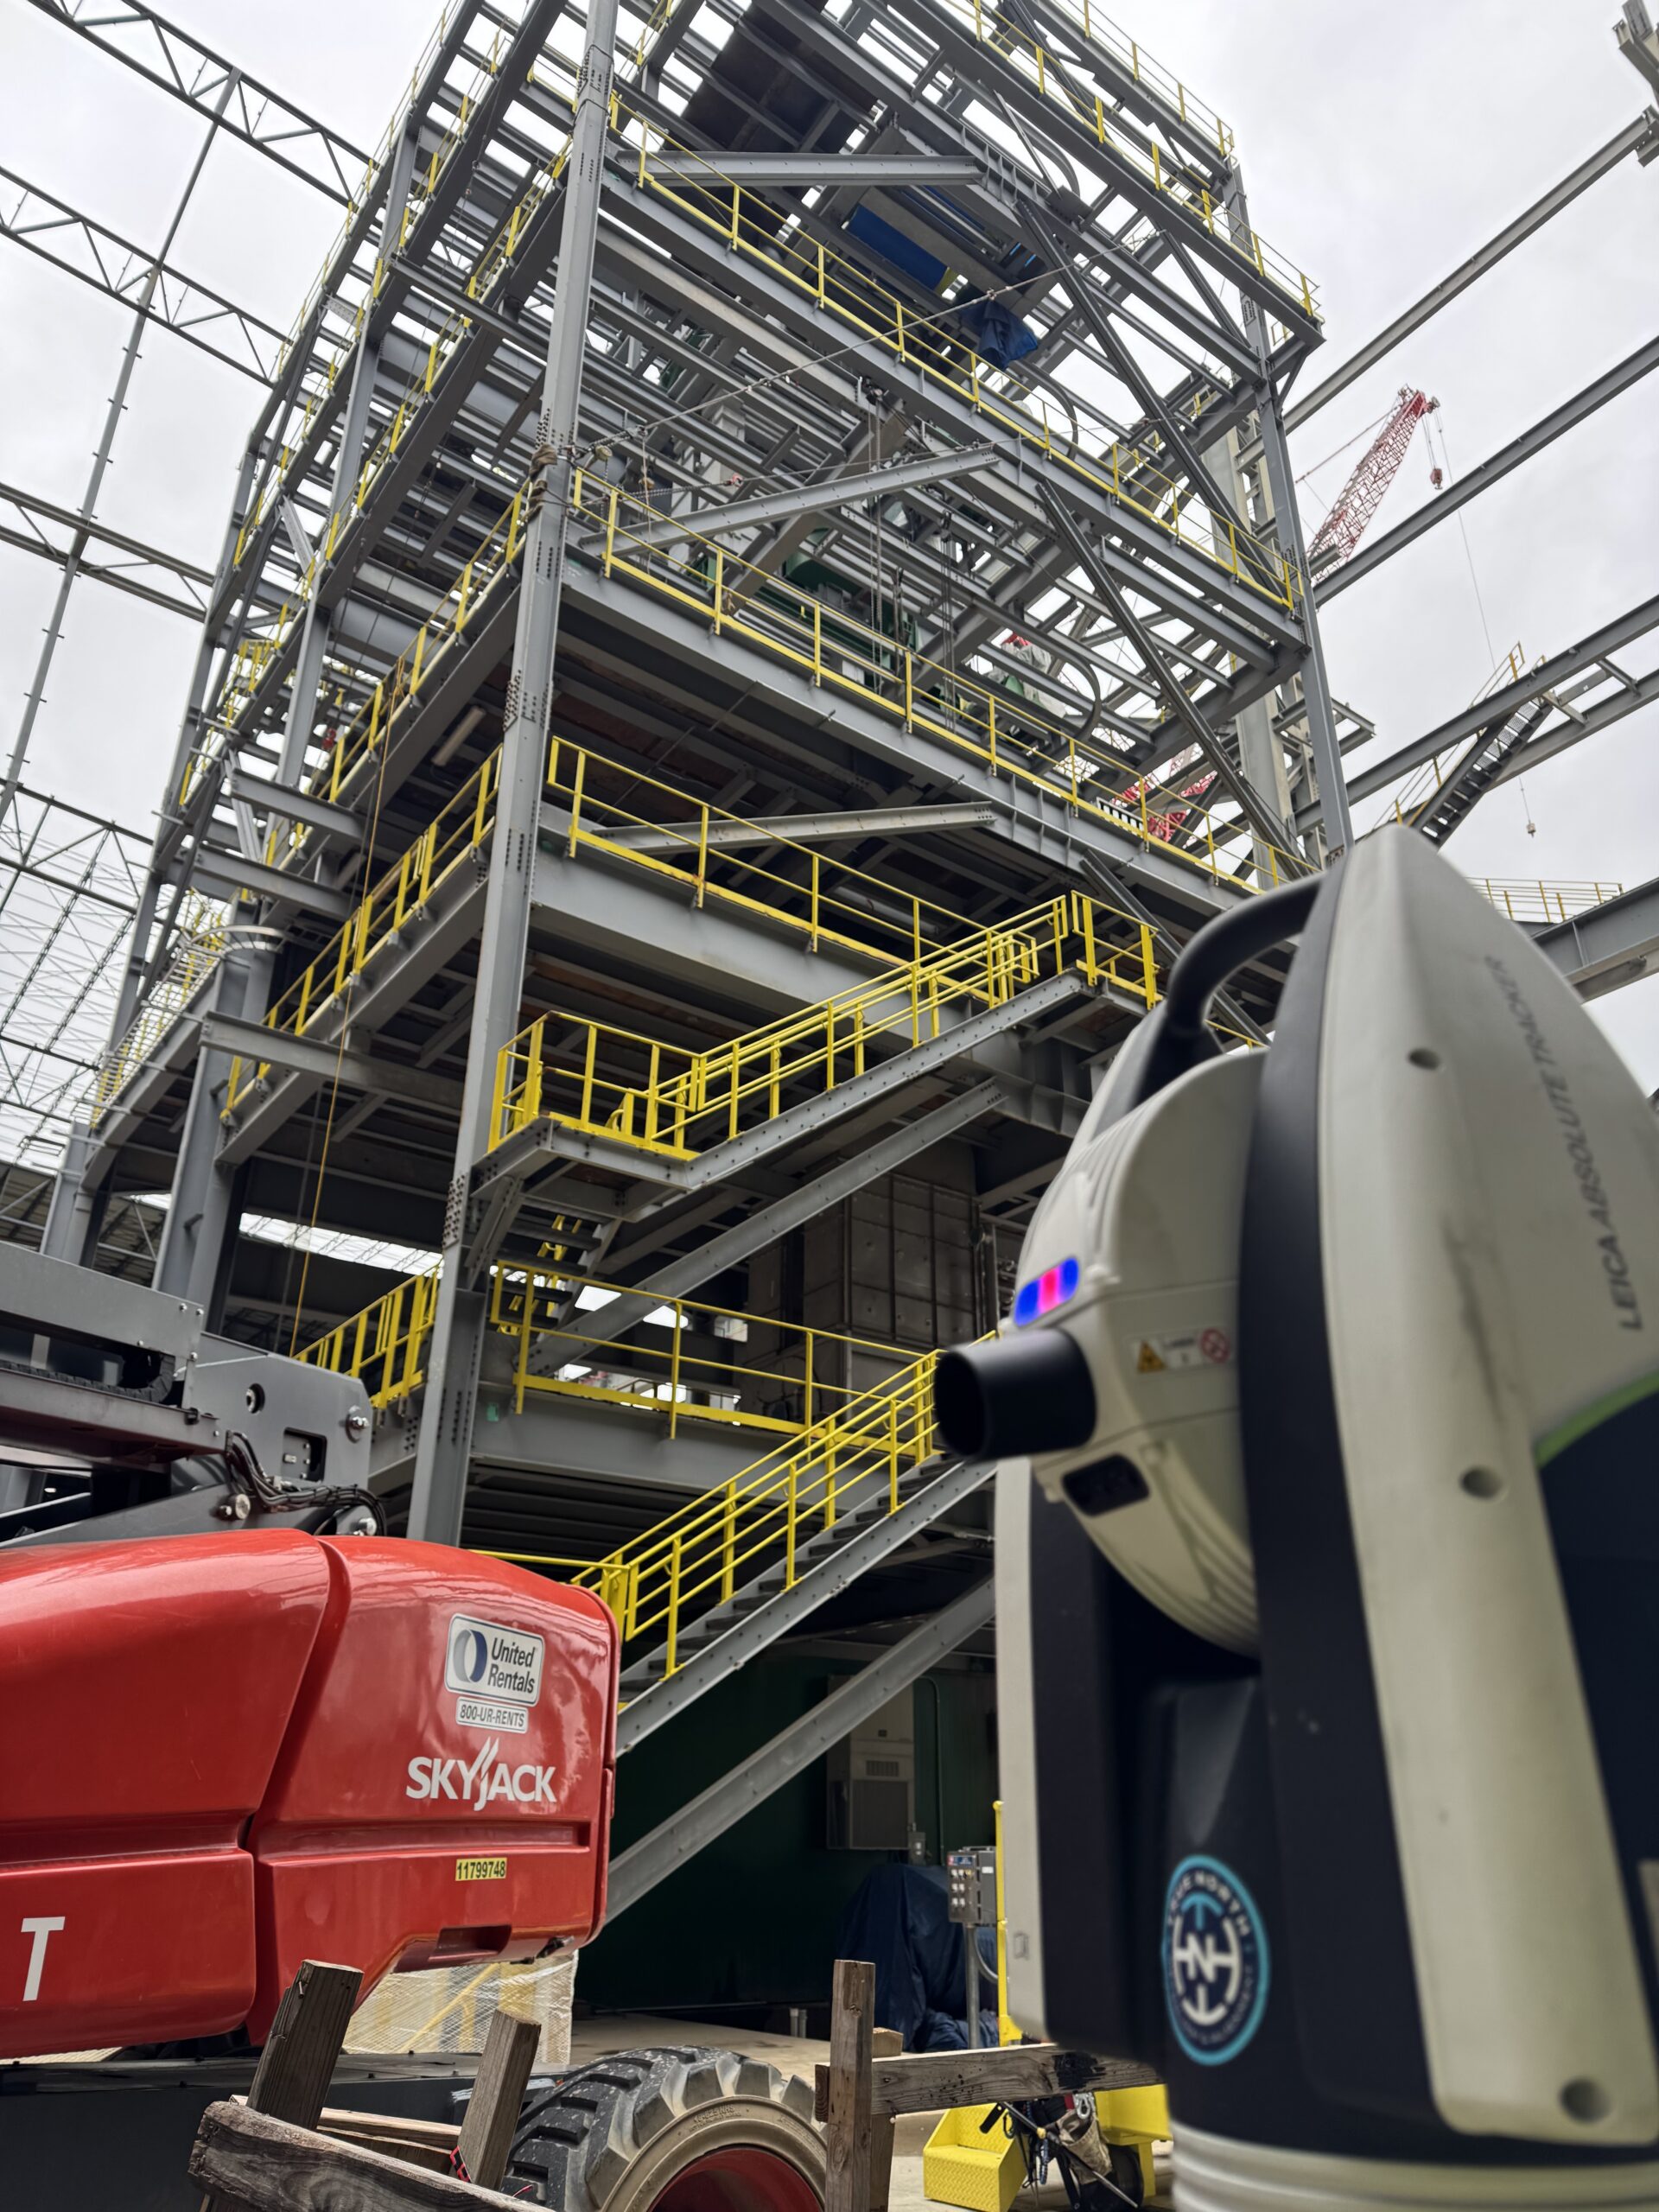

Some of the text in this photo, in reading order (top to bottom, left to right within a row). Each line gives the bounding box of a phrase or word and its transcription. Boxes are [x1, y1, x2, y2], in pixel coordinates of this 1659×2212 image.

[1540, 1069, 1617, 1232] ABSOLUTE
[1597, 1234, 1643, 1331] LEICA
[487, 1663, 536, 1694] Rentals
[491, 1637, 536, 1668] United
[460, 1704, 525, 1727] 800-UR-RENTS
[405, 1736, 557, 1811] SKYJACK
[456, 1860, 506, 1880] 11799748
[1194, 1870, 1251, 1936] NORTH
[21, 1916, 66, 2002] T
